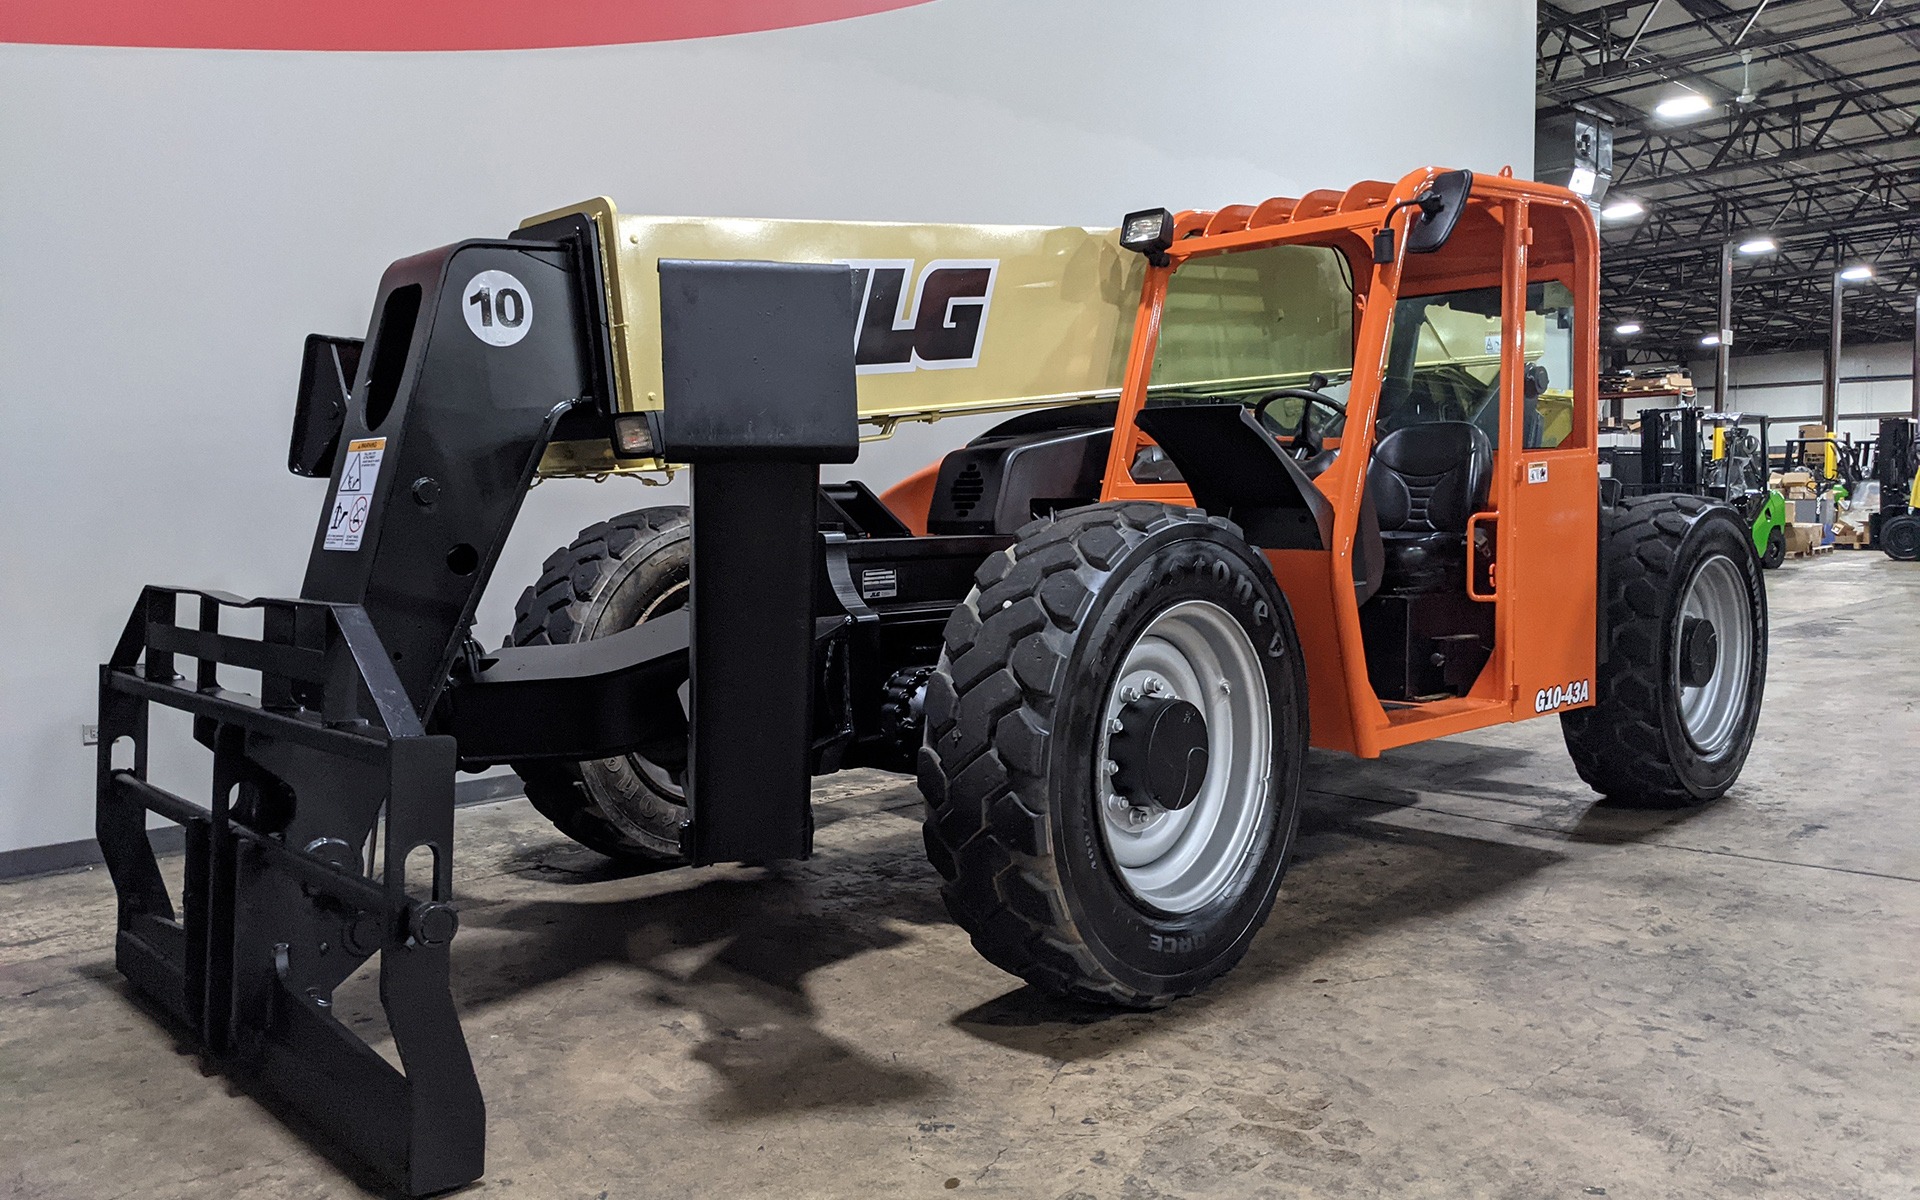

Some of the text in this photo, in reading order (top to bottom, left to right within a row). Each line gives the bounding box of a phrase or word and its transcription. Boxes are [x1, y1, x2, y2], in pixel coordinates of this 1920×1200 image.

[469, 287, 525, 329] 10
[850, 259, 1000, 375] LG
[1534, 679, 1590, 714] G10-43A
